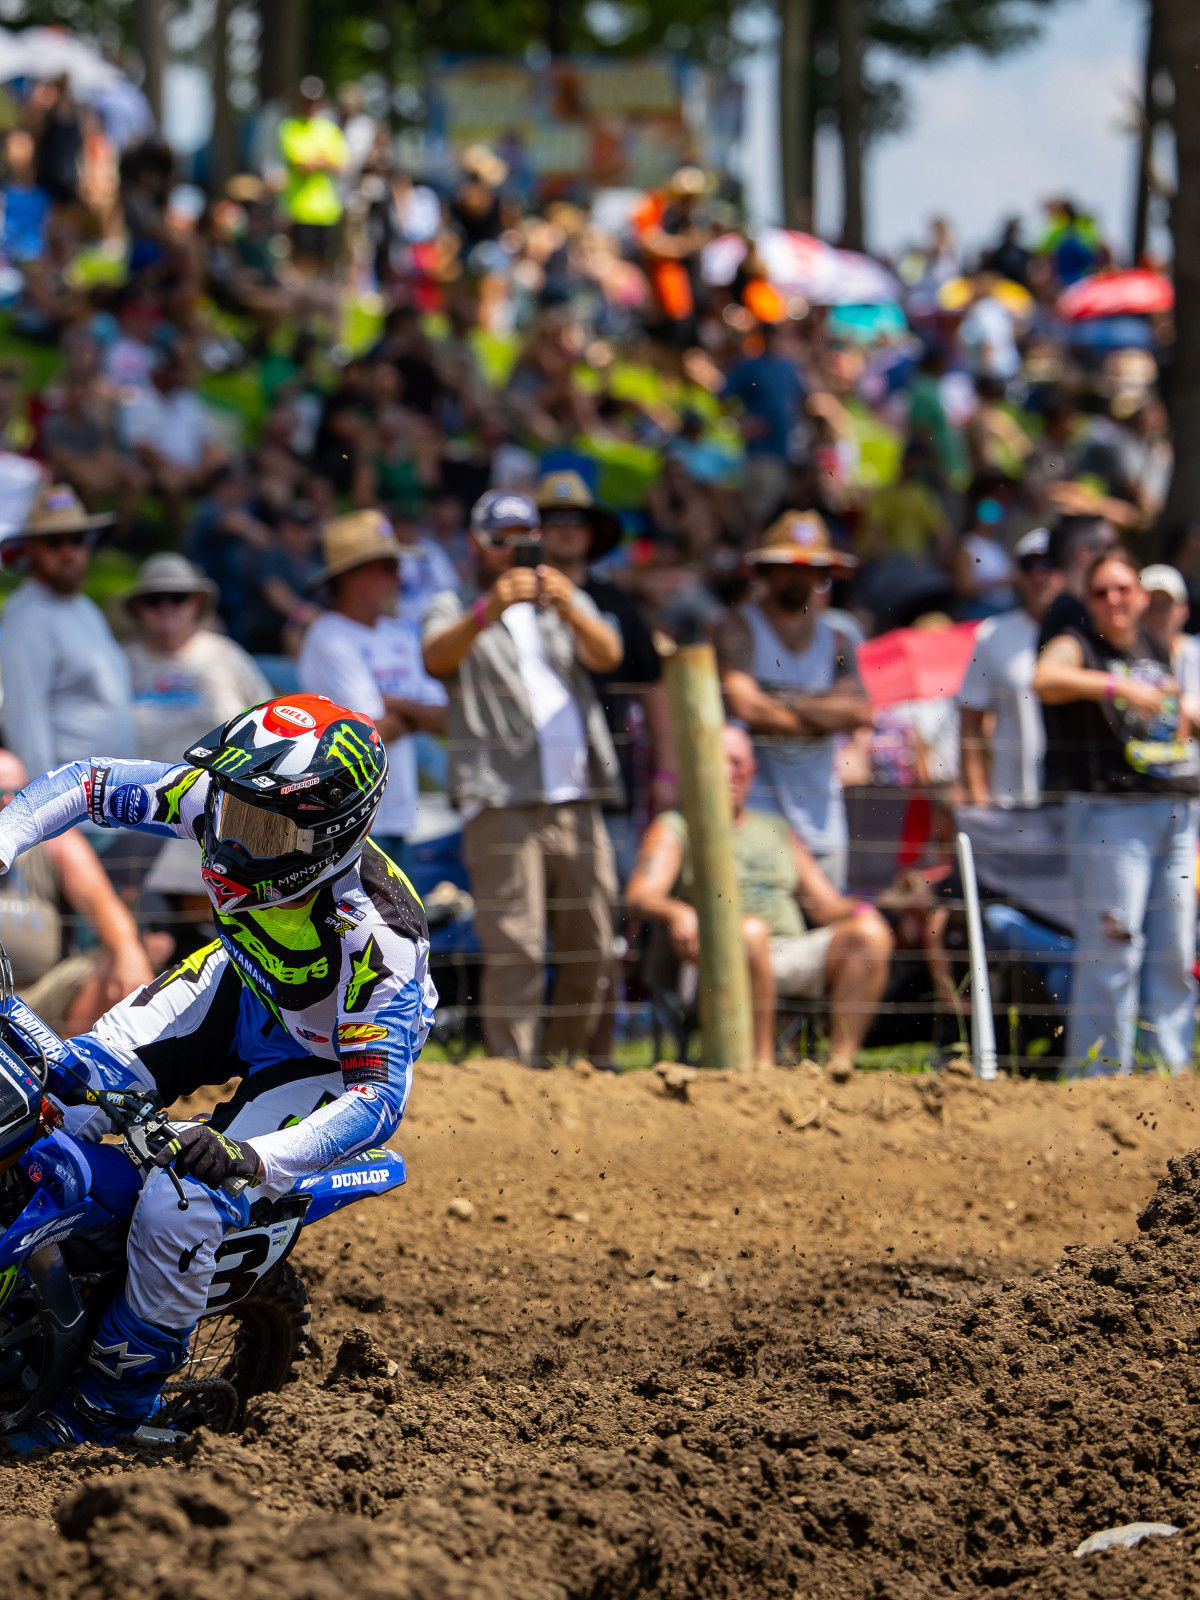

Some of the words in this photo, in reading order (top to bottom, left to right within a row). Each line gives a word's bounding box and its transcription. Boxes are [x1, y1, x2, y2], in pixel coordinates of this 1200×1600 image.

[280, 707, 308, 724] BELL
[278, 852, 340, 886] MONSTER
[324, 916, 352, 938] SMX
[232, 946, 273, 995] YAMAHA
[341, 1055, 382, 1070] YAMAHA
[331, 1169, 390, 1189] DUNLOP
[205, 1233, 270, 1311] 3
